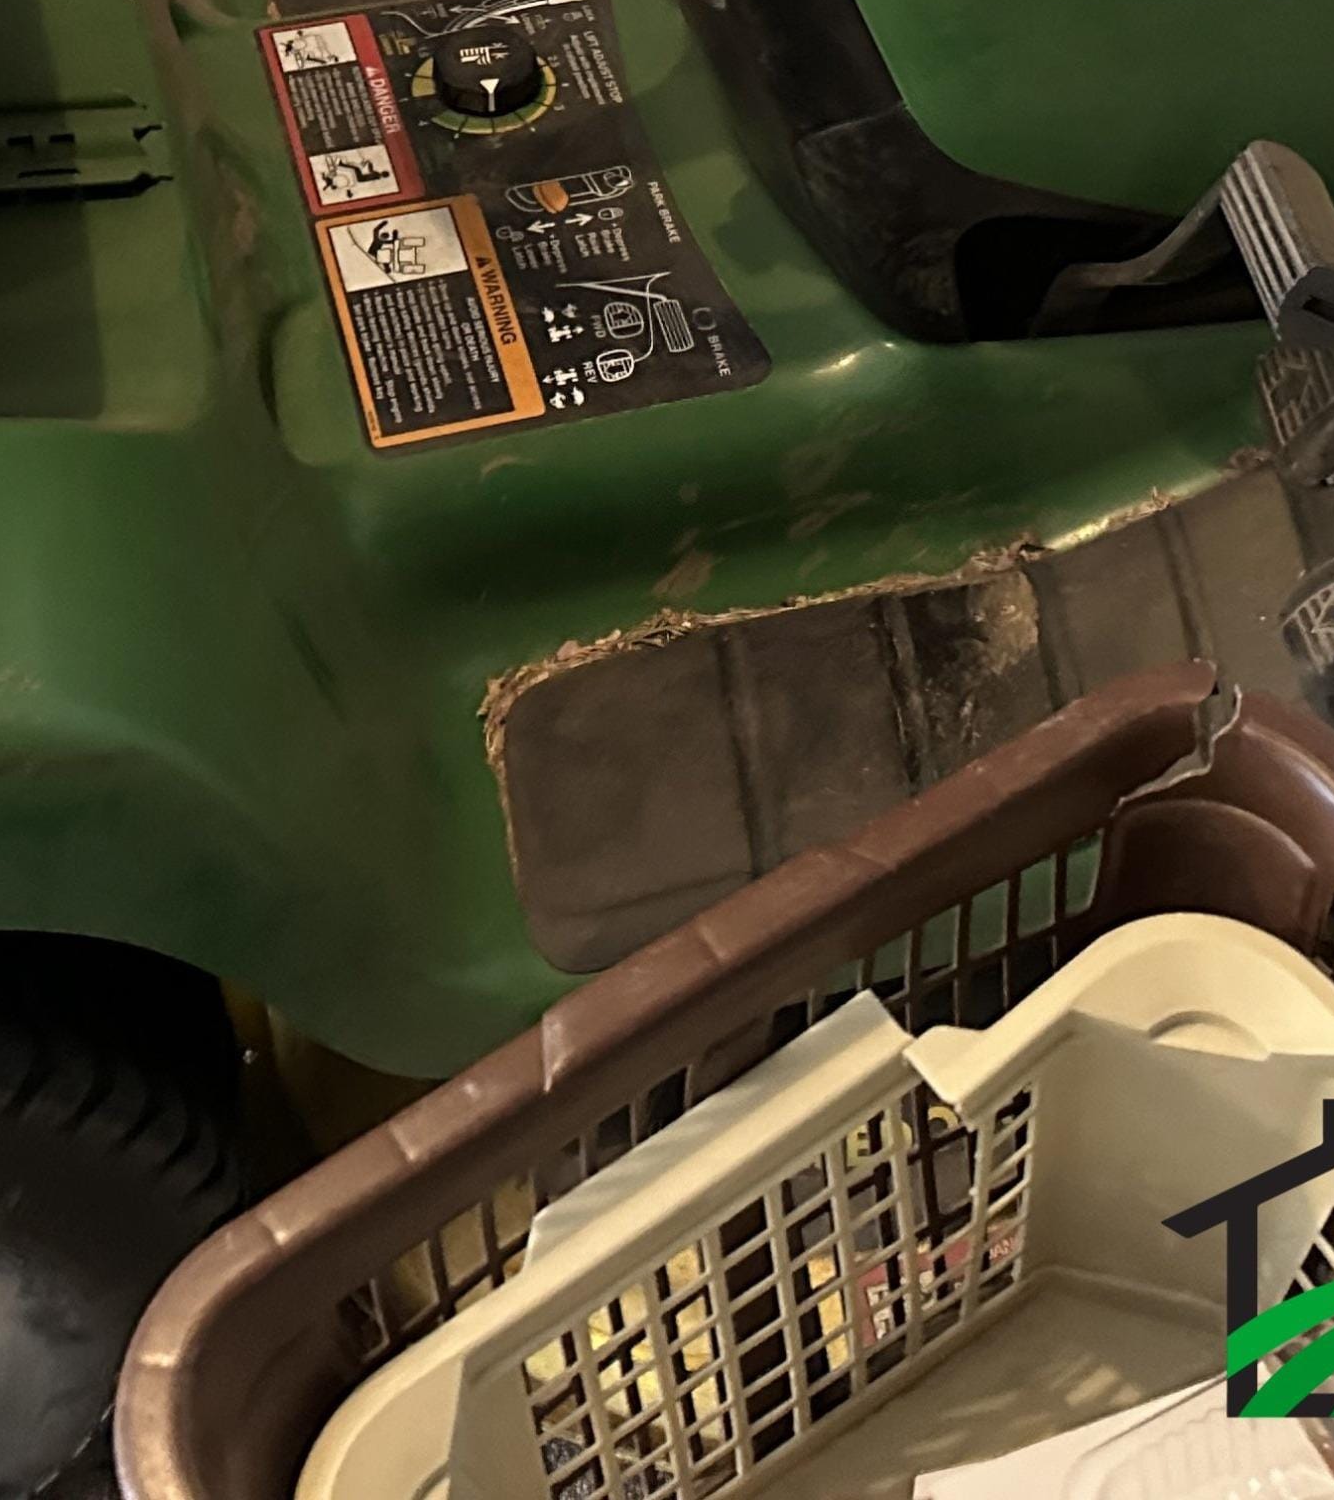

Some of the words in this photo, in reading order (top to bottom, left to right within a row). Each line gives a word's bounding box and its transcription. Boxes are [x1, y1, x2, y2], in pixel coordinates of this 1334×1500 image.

[583, 30, 598, 47] LIFT
[590, 47, 613, 79] ADJUST
[369, 77, 401, 133] DANGER
[605, 81, 623, 103] STOP
[647, 181, 665, 209] PARK
[659, 208, 681, 244] BRAKE
[479, 269, 518, 345] WARNING
[591, 315, 607, 339] FWD
[707, 335, 732, 377] BRAKE
[583, 361, 599, 384] REV
